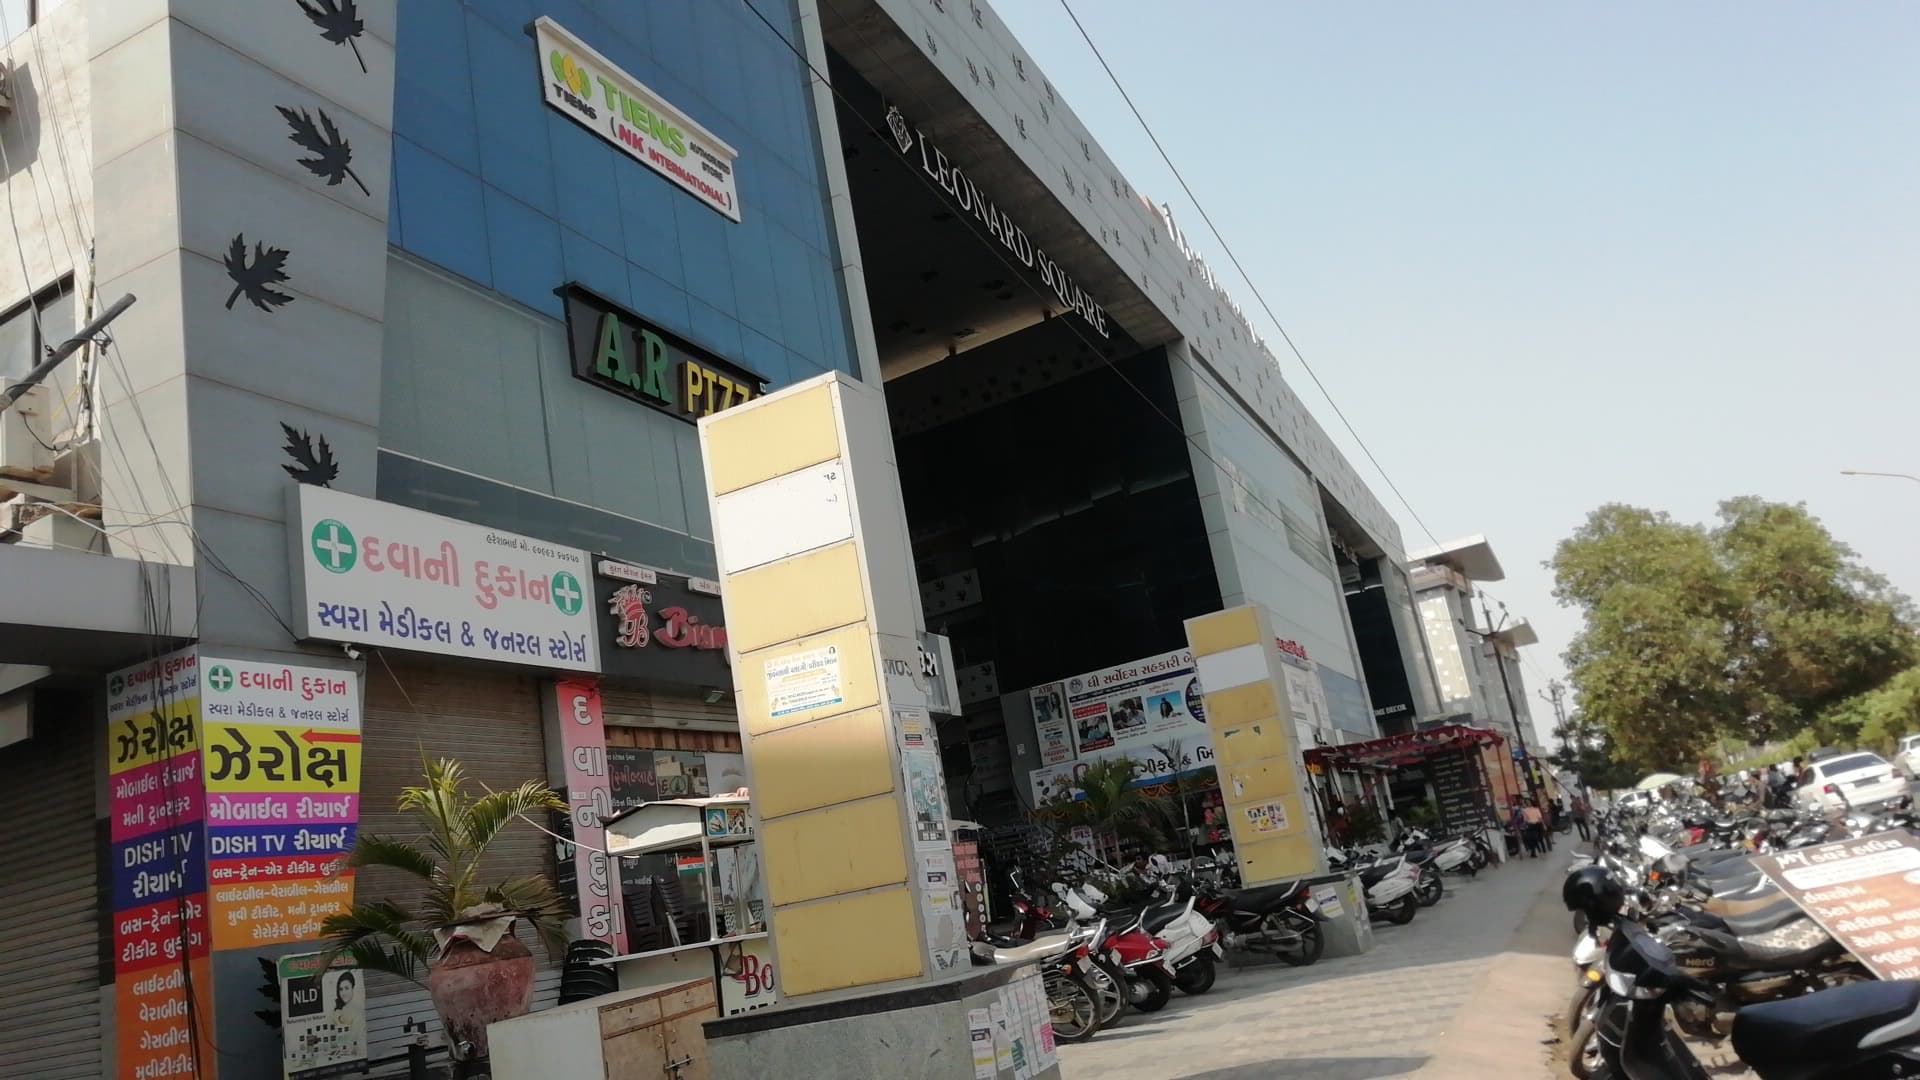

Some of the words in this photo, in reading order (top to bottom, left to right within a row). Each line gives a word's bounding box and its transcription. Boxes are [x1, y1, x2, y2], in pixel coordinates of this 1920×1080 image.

[553, 83, 597, 120] TIENS
[597, 75, 687, 158] TIENS
[916, 128, 1033, 268] LEONARD
[1038, 249, 1109, 339] SQUARE
[596, 311, 673, 404] A.R
[687, 360, 759, 416] PIZZ
[362, 535, 460, 588] દવાની
[474, 560, 551, 610] દુકાન
[317, 601, 369, 633] સ્વરા
[379, 600, 450, 644] મેડીકલ
[461, 621, 475, 648] &
[483, 627, 541, 656] જનરલ
[548, 630, 587, 663] સ્ટોર્સ
[1141, 655, 1180, 675] સહકારી
[239, 668, 294, 692] દવાની
[301, 676, 347, 701] દુકાન
[208, 702, 233, 716] સ્વરા
[237, 700, 274, 718] મેડીકલ
[279, 708, 286, 719] &
[290, 708, 323, 721] જનરલ
[117, 711, 194, 764] ઝેરોક્ષ
[210, 727, 348, 789] ઝેરોક્ષ
[210, 795, 288, 820] મોબાઈલ
[296, 795, 352, 820] રીચાર્જ
[125, 838, 165, 868] DISH
[171, 831, 192, 855] TV
[211, 835, 257, 855] DISH
[262, 834, 286, 852] TV
[293, 826, 348, 851] રીચાર્જ
[287, 861, 316, 875] ટીકીટ
[1776, 851, 1811, 868] MY
[292, 987, 318, 1005] NLD
